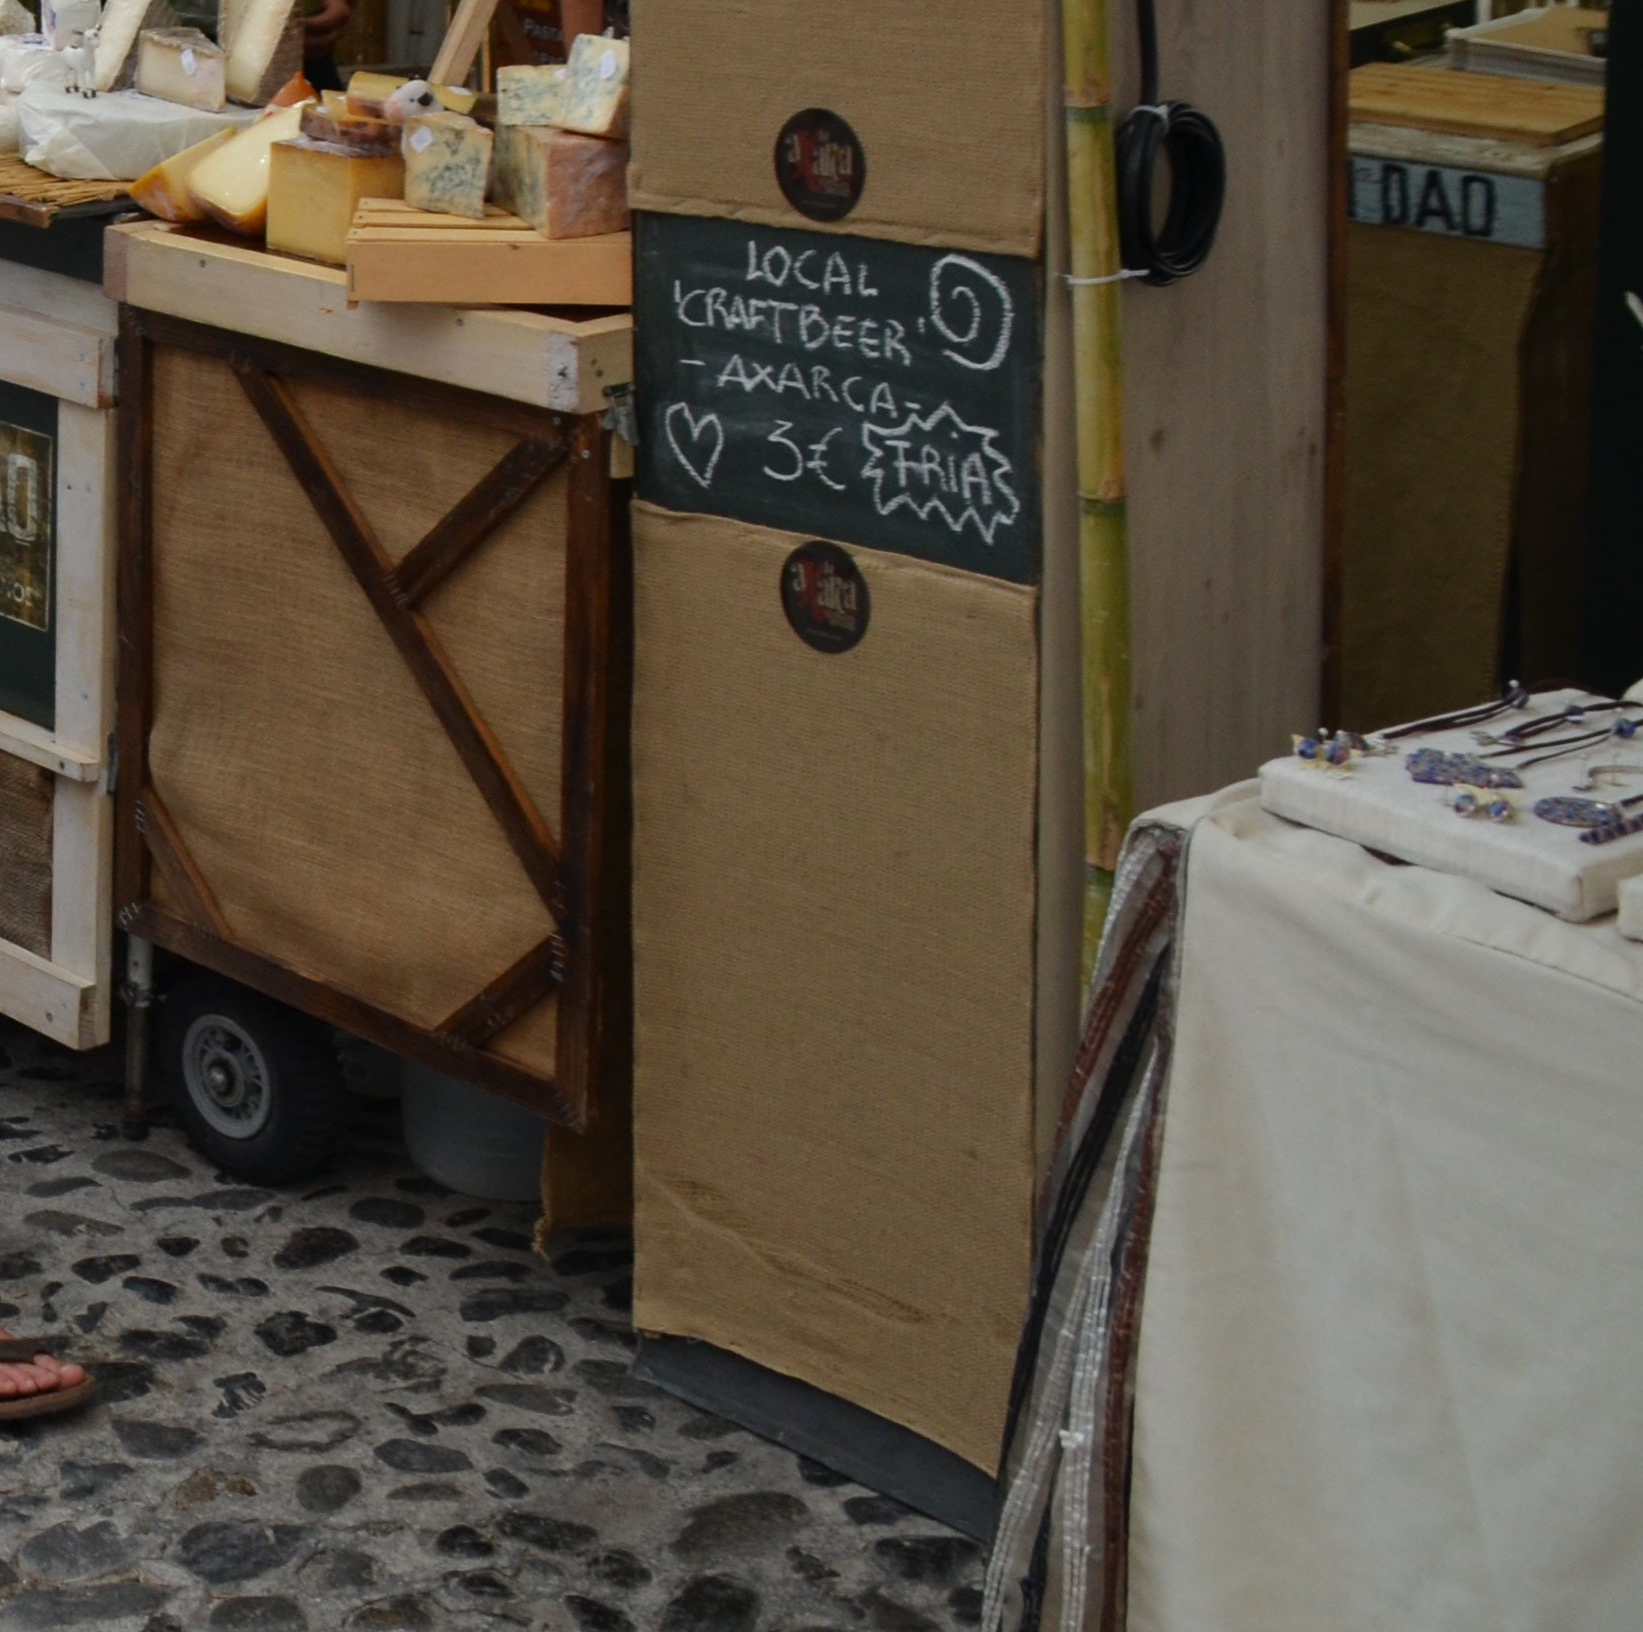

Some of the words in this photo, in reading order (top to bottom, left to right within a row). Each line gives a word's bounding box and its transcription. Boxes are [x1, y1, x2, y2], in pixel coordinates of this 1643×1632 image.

[1380, 163, 1496, 238] DAO
[746, 240, 878, 296] LOCAL
[763, 419, 845, 491] 3€
